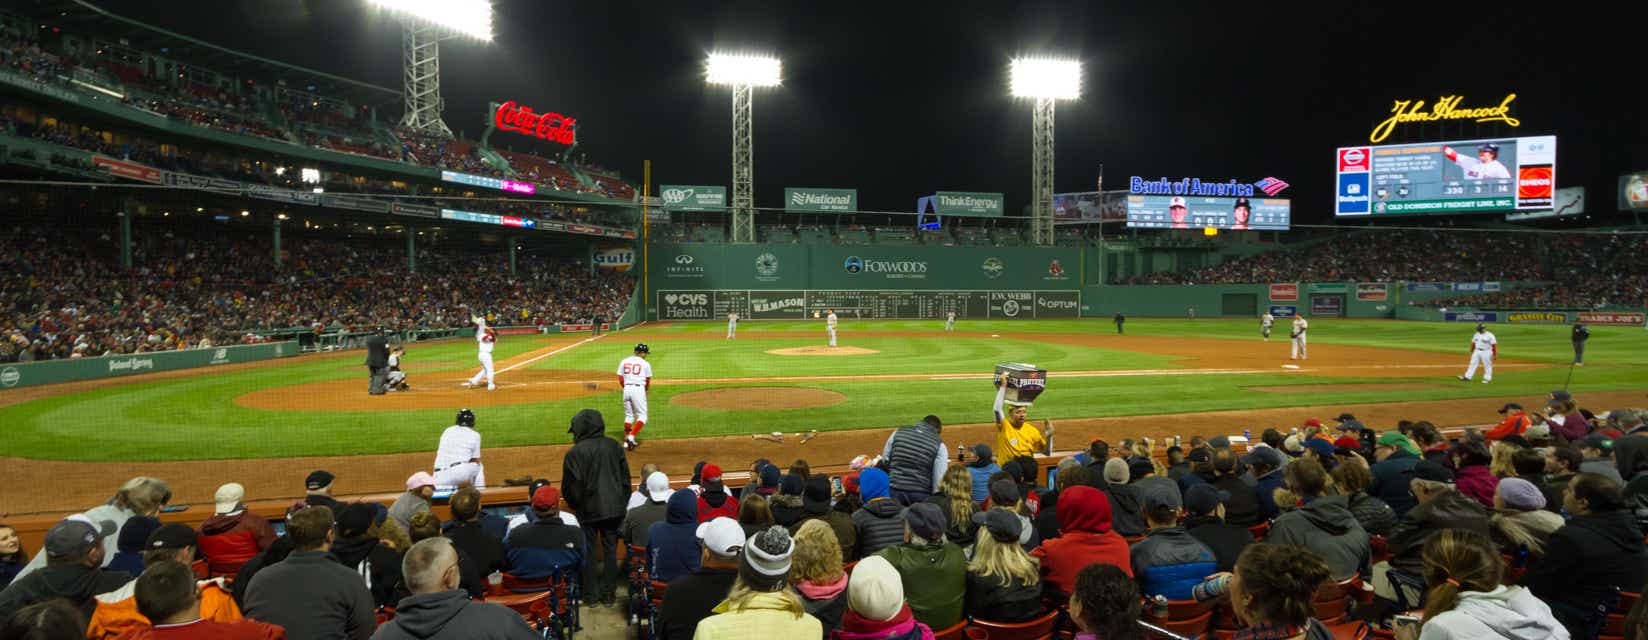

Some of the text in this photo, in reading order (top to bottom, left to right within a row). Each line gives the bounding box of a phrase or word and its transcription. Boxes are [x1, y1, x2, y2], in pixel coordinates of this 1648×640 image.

[1370, 93, 1520, 142] John Hancock
[1130, 176, 1254, 197] Bank of America
[664, 189, 684, 203] AAA
[804, 193, 851, 205] National
[593, 251, 633, 264] Gulf
[679, 294, 709, 306] CVS
[1007, 292, 1032, 300] WEBB
[1047, 300, 1077, 309] OPTUM
[666, 306, 709, 318] Health
